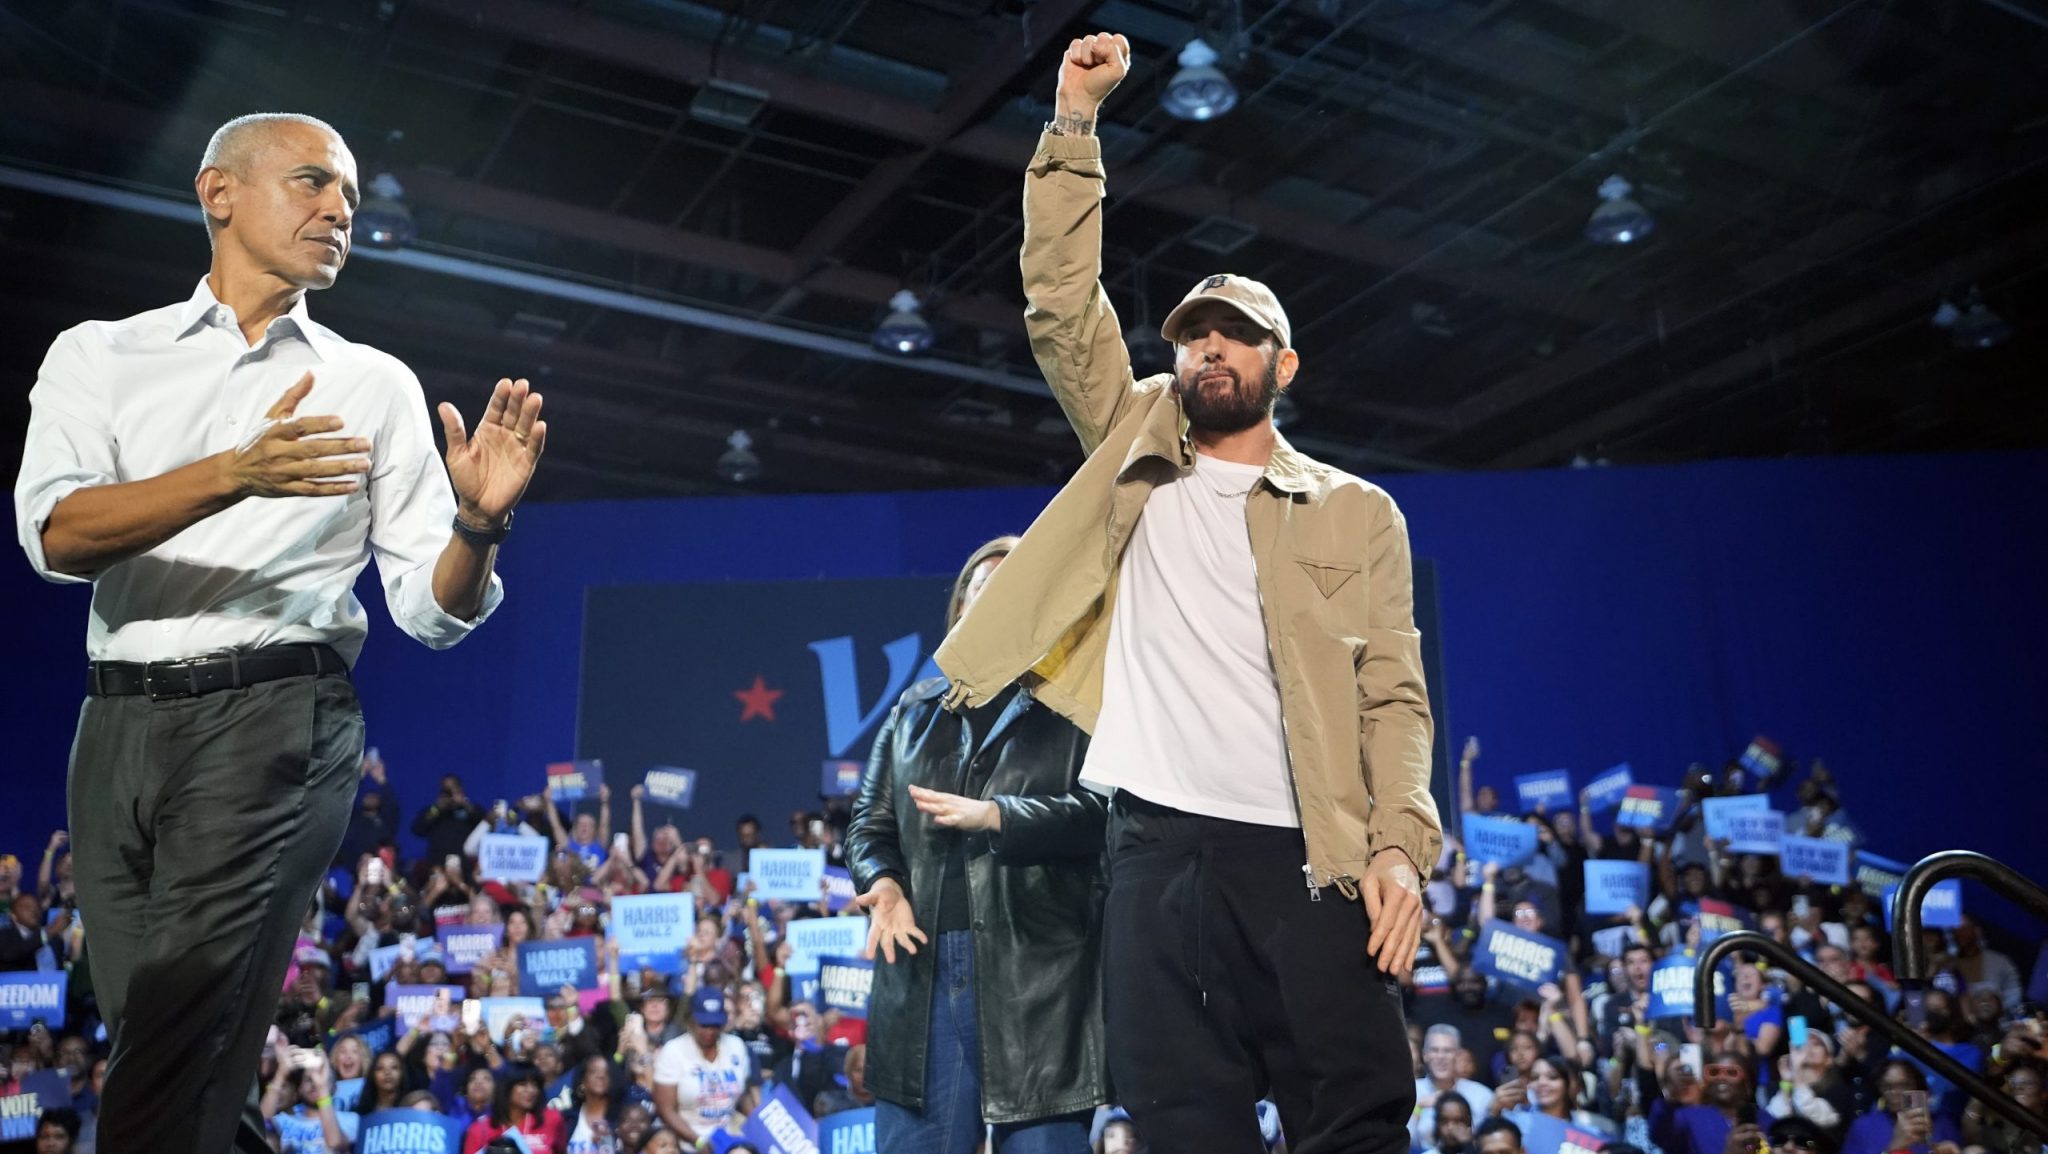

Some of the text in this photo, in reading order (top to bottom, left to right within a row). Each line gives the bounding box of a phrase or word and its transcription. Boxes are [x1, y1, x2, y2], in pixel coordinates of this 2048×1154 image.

[807, 632, 944, 757] V
[1474, 828, 1519, 849] HARRIS
[760, 859, 811, 877] HARRIS
[768, 878, 804, 889] WALZ
[623, 905, 680, 925] HARRIS
[632, 925, 672, 938] WALZ
[797, 929, 853, 948] HARRIS
[447, 934, 495, 955] HARRIS
[1488, 929, 1556, 972] HARRIS
[526, 947, 586, 975] HARRIS
[1495, 954, 1540, 982] WALZ
[535, 969, 578, 987] WALZ
[820, 964, 875, 996] HARRIS
[824, 989, 865, 1008] WALZ
[363, 1121, 446, 1154] HARRIS
